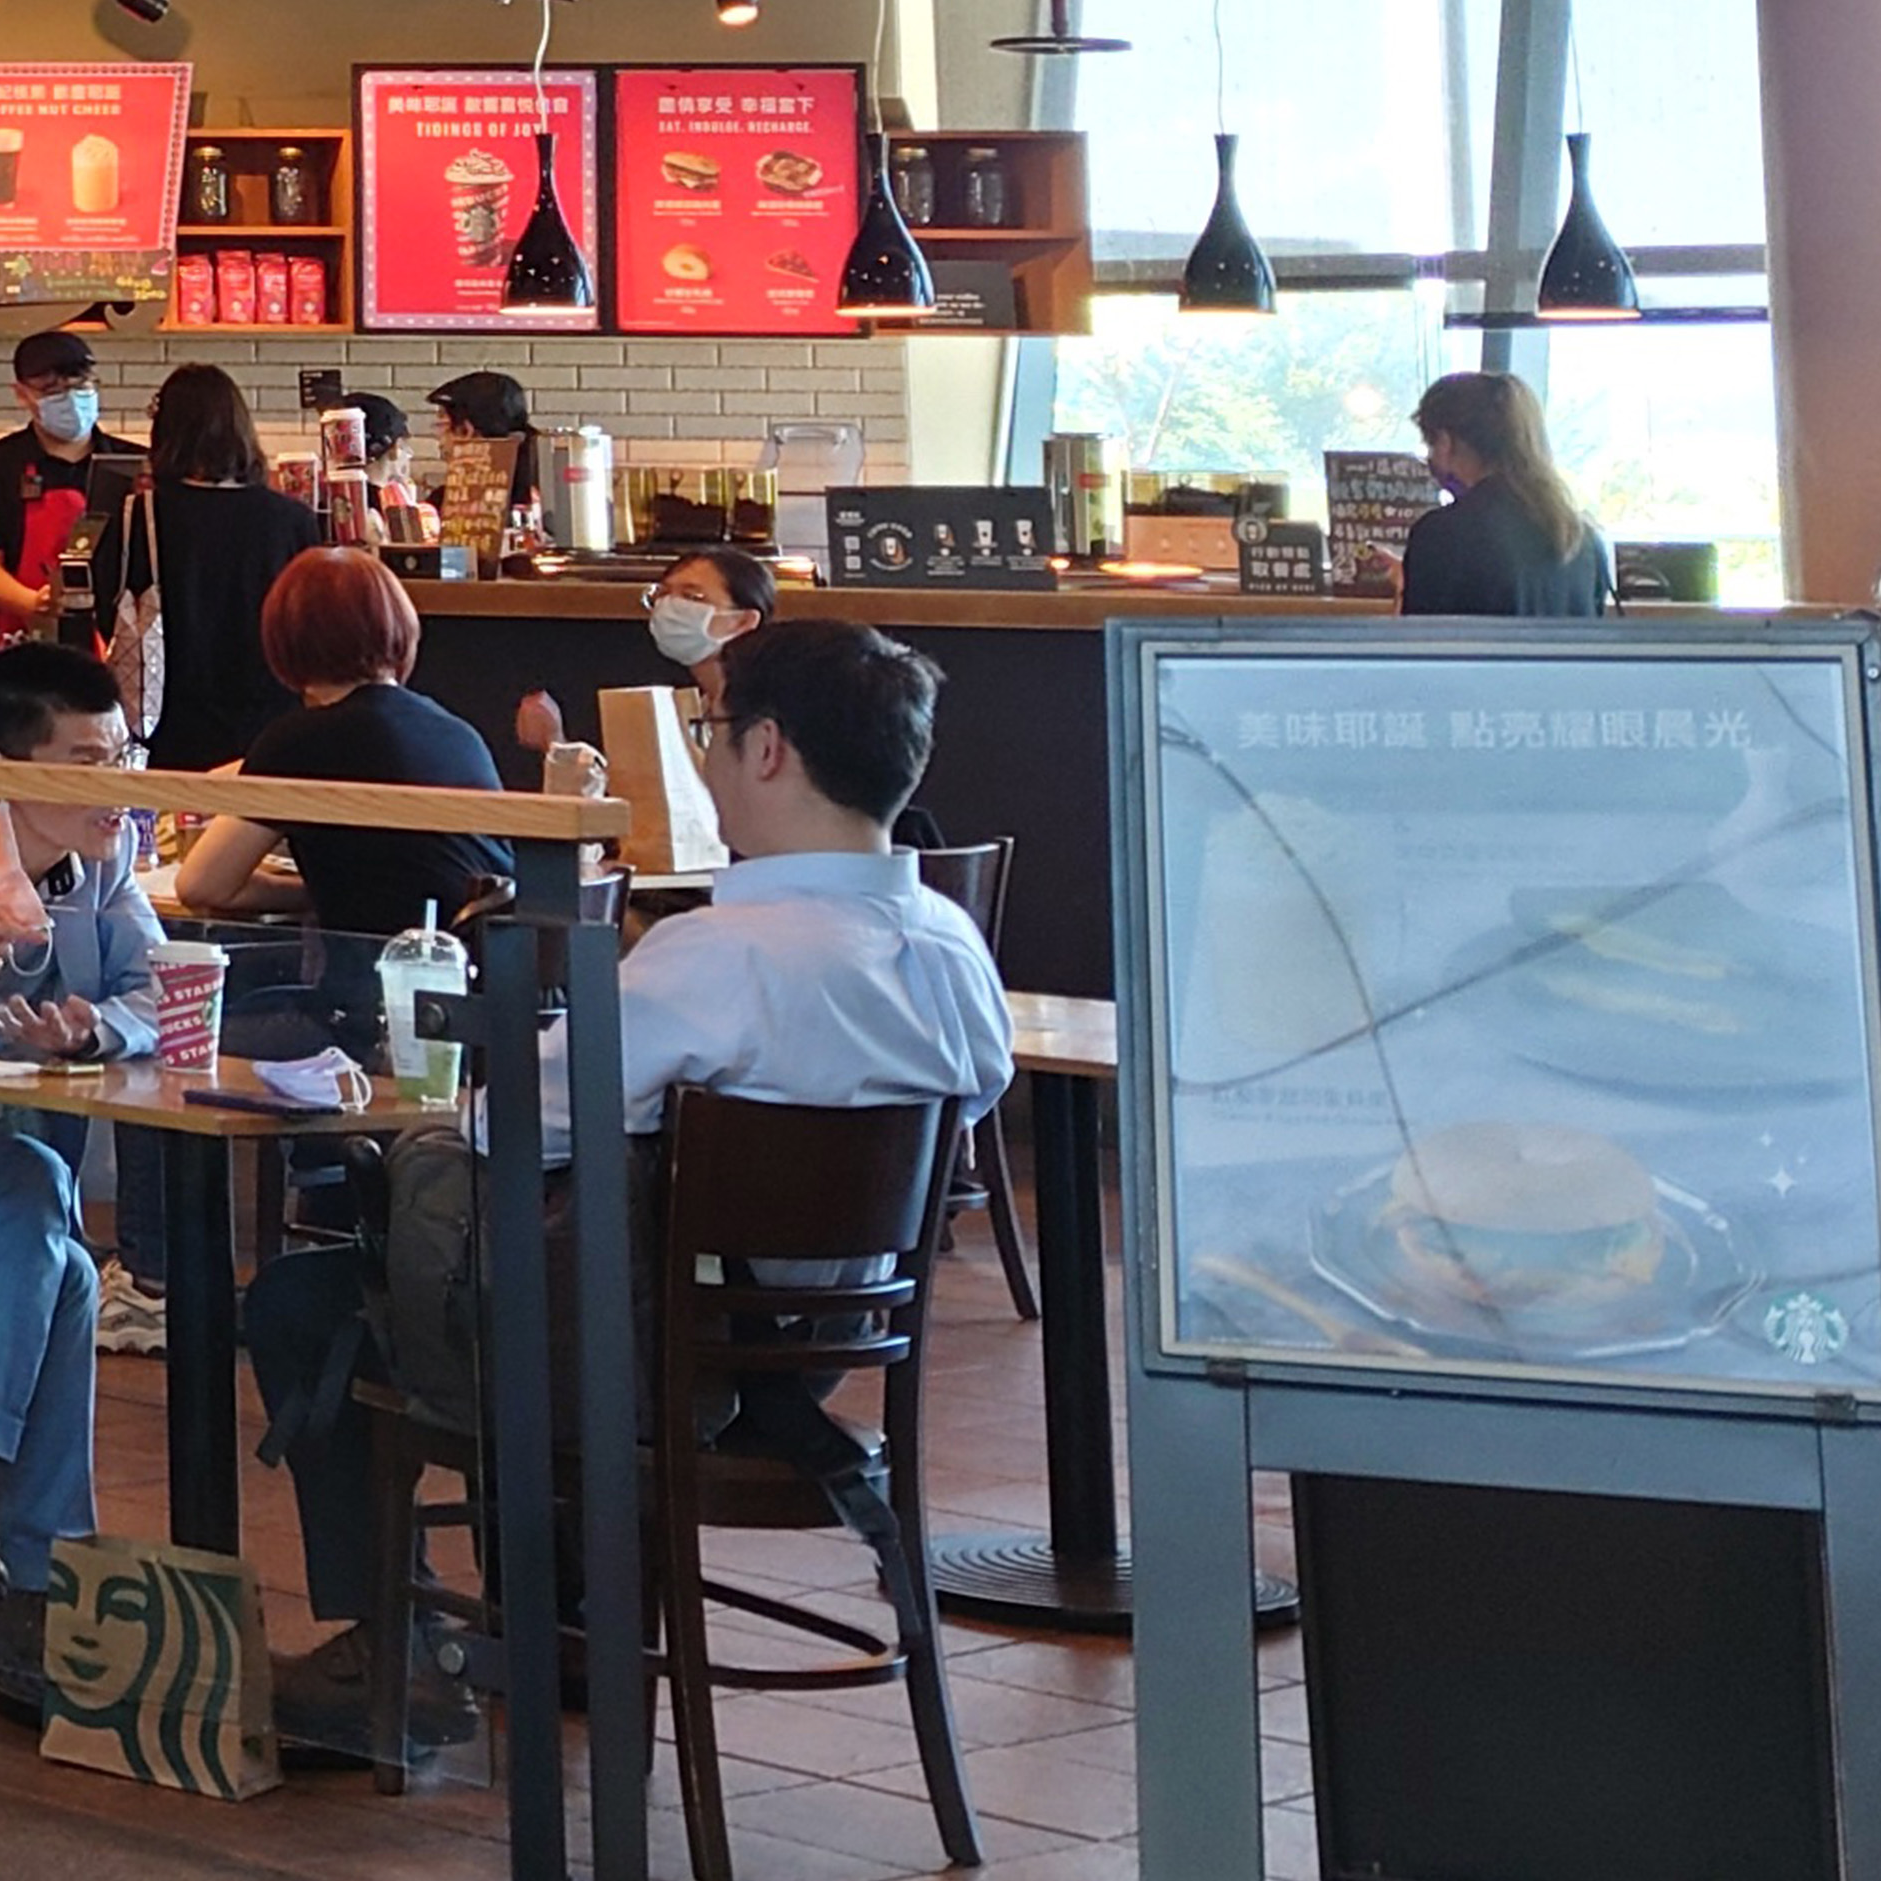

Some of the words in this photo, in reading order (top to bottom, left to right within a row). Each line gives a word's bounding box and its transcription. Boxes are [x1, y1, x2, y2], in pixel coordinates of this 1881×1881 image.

[38, 103, 69, 115] NUT
[72, 103, 121, 116] CHEER
[417, 121, 482, 137] TIDINGS
[488, 121, 507, 137] OF
[1251, 561, 1312, 579] 取餐處
[1239, 709, 1428, 750] 美味耶誕
[1450, 708, 1752, 751] 點亮耀眼晨光
